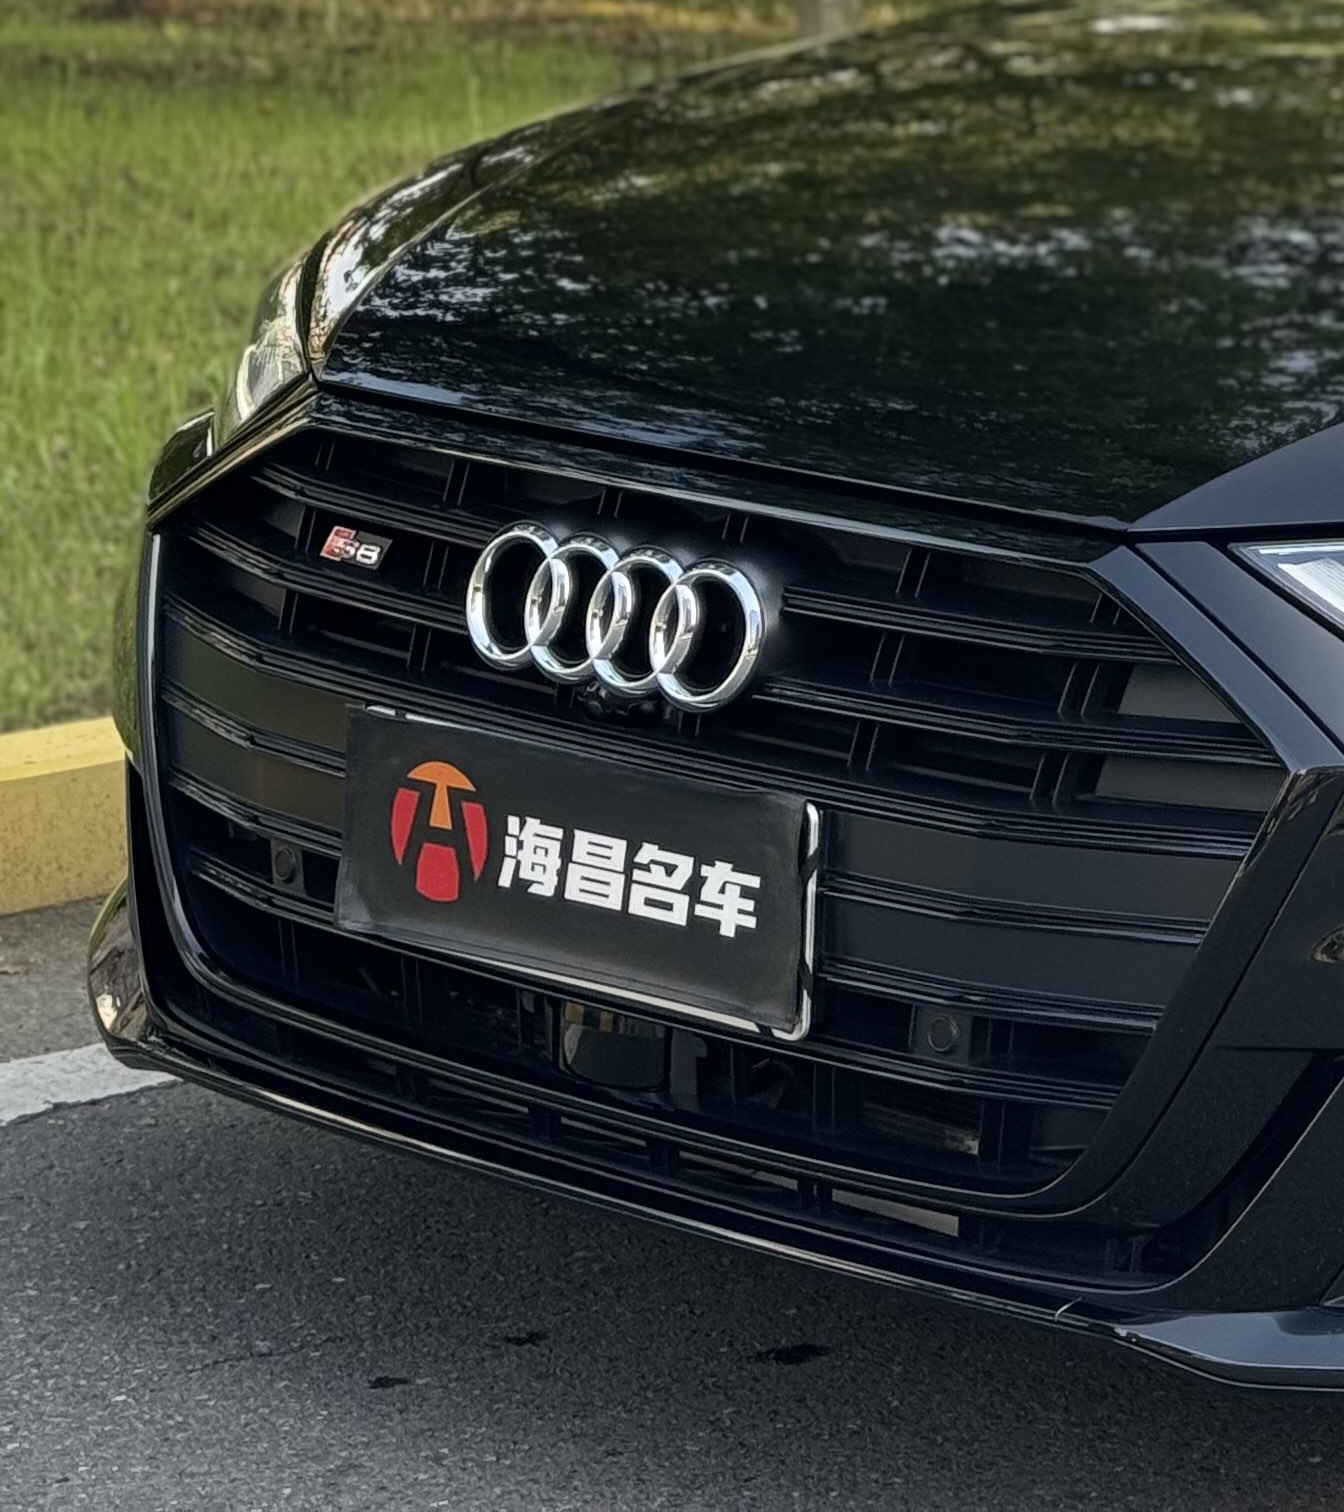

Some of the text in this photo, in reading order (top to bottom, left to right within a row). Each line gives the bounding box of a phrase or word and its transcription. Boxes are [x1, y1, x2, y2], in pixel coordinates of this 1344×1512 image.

[326, 532, 382, 565] S8
[498, 814, 762, 938] 海昌名车
